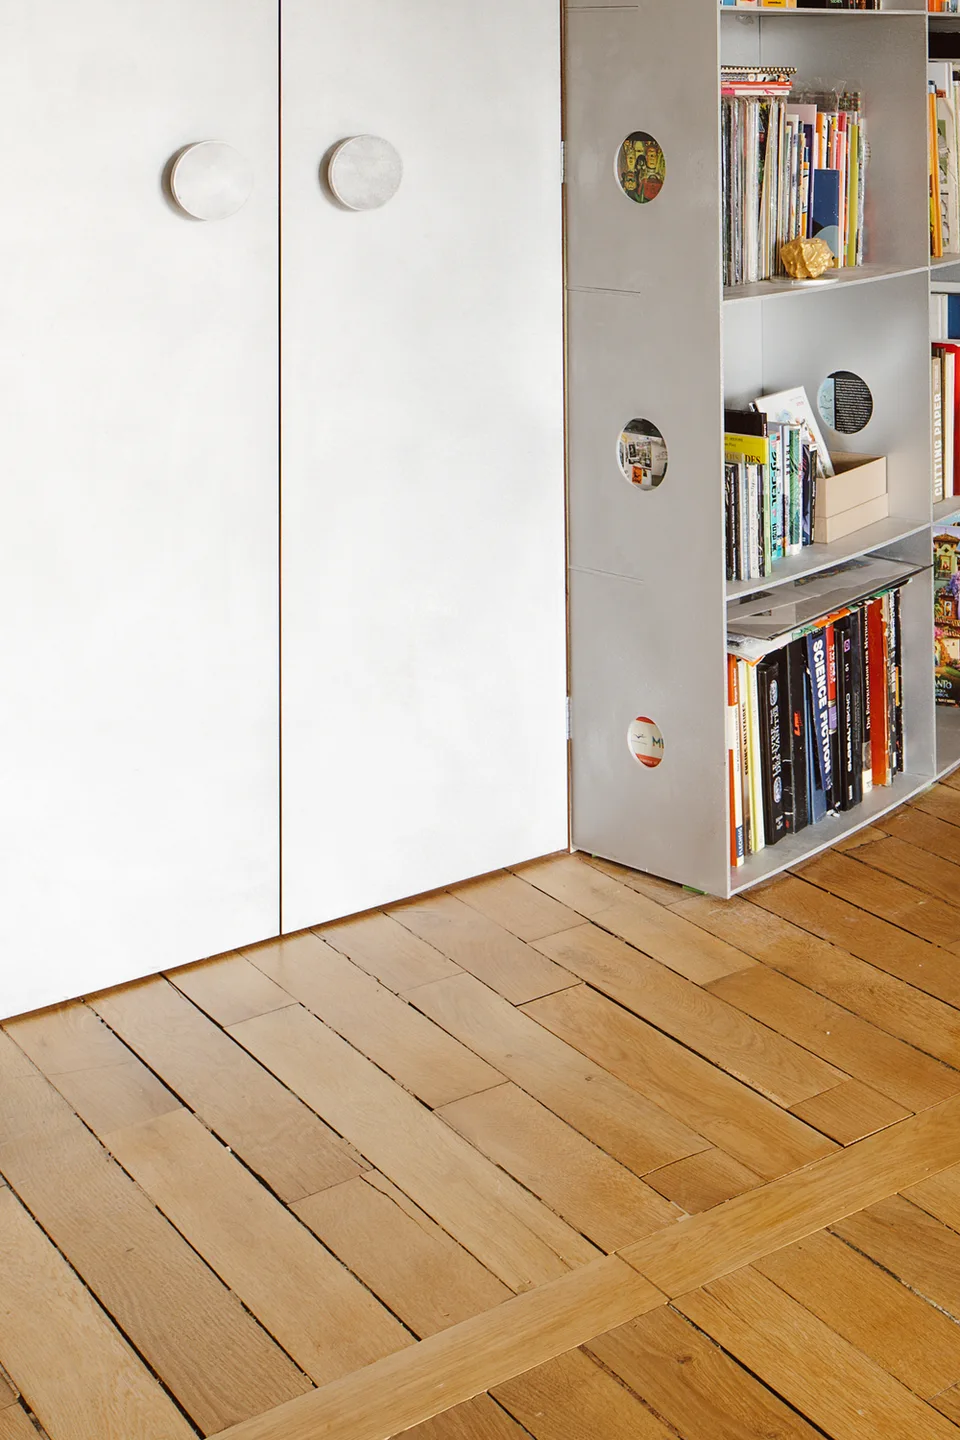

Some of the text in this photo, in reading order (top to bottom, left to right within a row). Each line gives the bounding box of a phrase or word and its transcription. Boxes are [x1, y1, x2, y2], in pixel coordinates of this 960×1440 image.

[933, 391, 943, 497] CUTTING PAPER
[812, 639, 831, 774] SCIENCE FICTION
